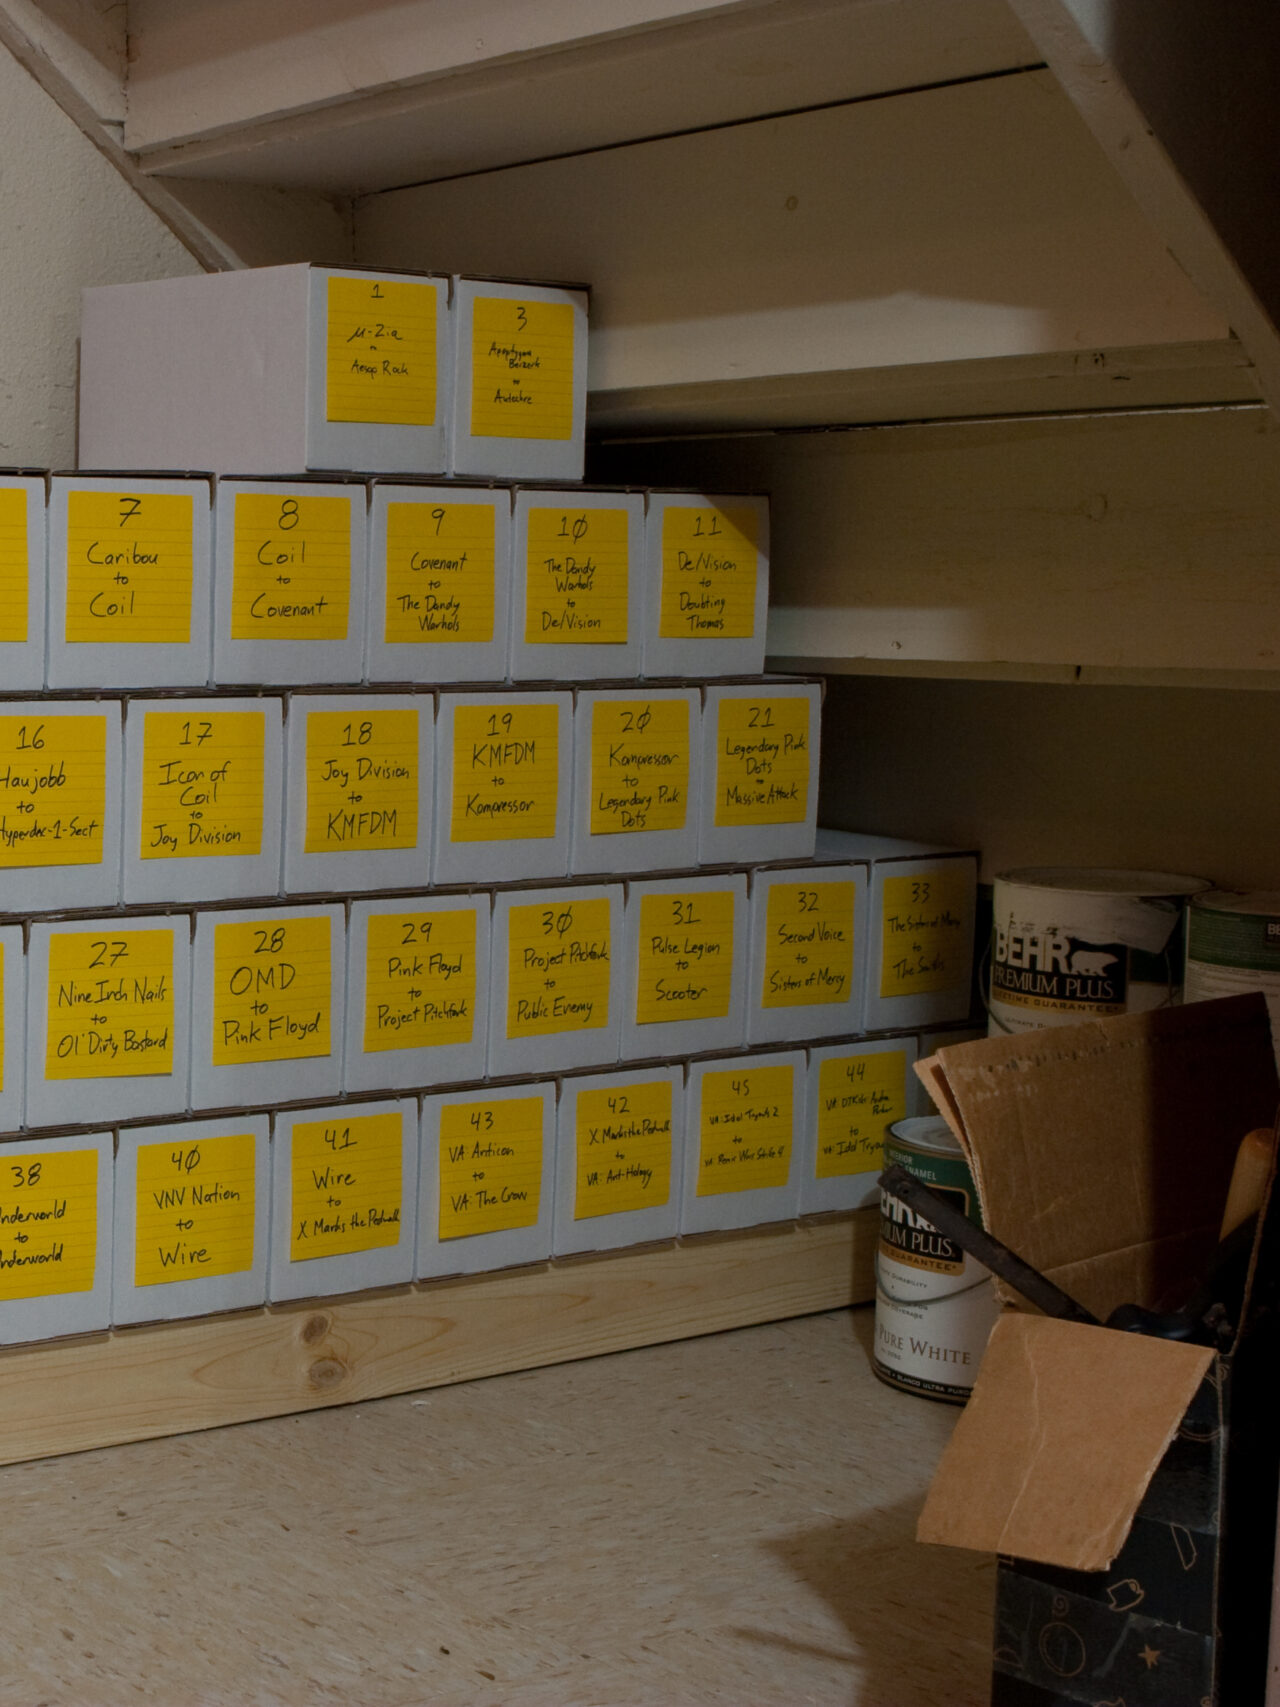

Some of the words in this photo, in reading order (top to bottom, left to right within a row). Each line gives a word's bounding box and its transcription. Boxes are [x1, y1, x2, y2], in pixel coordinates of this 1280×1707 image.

[370, 284, 385, 299] 1
[516, 306, 528, 332] 3
[119, 497, 142, 527] 7
[278, 498, 299, 531] 8
[431, 508, 446, 535] 9
[692, 516, 722, 537] 11
[86, 541, 159, 565] Caribou
[257, 540, 305, 566] Coil
[410, 551, 468, 571] Covenant
[678, 550, 737, 571] De/Vision
[543, 558, 562, 572] The
[565, 556, 596, 581] Dandy
[89, 591, 135, 618] Coil
[250, 592, 329, 619] Covenant
[396, 594, 421, 612] The
[424, 594, 461, 617] Dandy
[541, 610, 601, 631] De/Vision
[487, 712, 513, 737] 19
[748, 707, 775, 728] 21
[16, 724, 45, 750] 16
[179, 721, 213, 746] 17
[341, 721, 373, 747] 18
[472, 740, 536, 769] KMFDM
[746, 756, 772, 775] Dots
[210, 760, 232, 782] of
[322, 759, 349, 788] Joy
[356, 757, 410, 781] Division
[179, 783, 217, 807] Coil
[327, 808, 397, 841] KMFDM
[620, 810, 646, 828] Dots
[150, 823, 178, 852] Joy
[188, 822, 241, 845] Division
[798, 891, 819, 913] 32
[911, 882, 930, 903] 33
[672, 900, 701, 926] 31
[254, 927, 286, 954] 28
[401, 921, 433, 945] 29
[778, 923, 816, 945] Second
[817, 921, 845, 942] Voice
[88, 941, 129, 969] 27
[523, 947, 567, 973] Project
[994, 926, 1072, 975] BEHR
[229, 962, 296, 996] OMD
[388, 956, 424, 978] Pink
[428, 952, 462, 981] Floyd
[134, 975, 167, 1004] Nails
[655, 978, 708, 1001] Scooter
[804, 972, 816, 987] of
[1065, 978, 1114, 999] PLUS
[377, 1004, 421, 1030] Project
[517, 996, 548, 1022] Public
[222, 1019, 261, 1046] Pink
[268, 1011, 321, 1041] Floyd
[87, 1030, 119, 1059] Dirty
[846, 1063, 866, 1083] 44
[732, 1079, 750, 1097] 45
[607, 1096, 630, 1114] 42
[470, 1111, 494, 1131] 43
[324, 1127, 358, 1151] 41
[10, 1162, 42, 1188] 38
[312, 1166, 356, 1190] Wire
[153, 1186, 186, 1210] VNV
[192, 1182, 240, 1205] Nation
[475, 1190, 498, 1208] The
[158, 1242, 212, 1267] Wire
[911, 1231, 953, 1258] PLUS
[878, 1323, 904, 1351] PURE
[909, 1337, 971, 1365] WHITE
[922, 1383, 945, 1393] ULTRA
